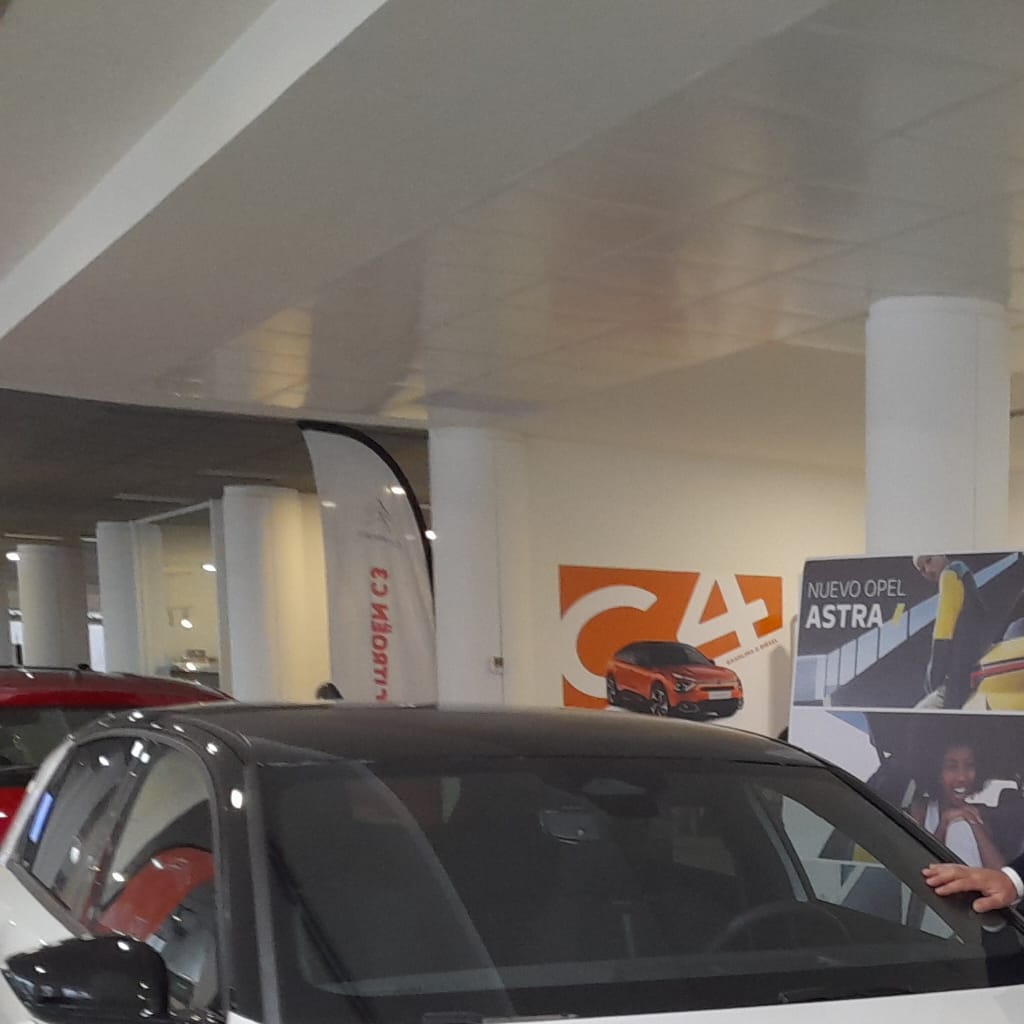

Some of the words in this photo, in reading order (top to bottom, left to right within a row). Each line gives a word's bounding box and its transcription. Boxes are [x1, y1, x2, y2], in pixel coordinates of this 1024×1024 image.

[807, 580, 862, 598] NUEVO
[864, 579, 907, 597] OPEL
[805, 603, 884, 629] ASTRA
